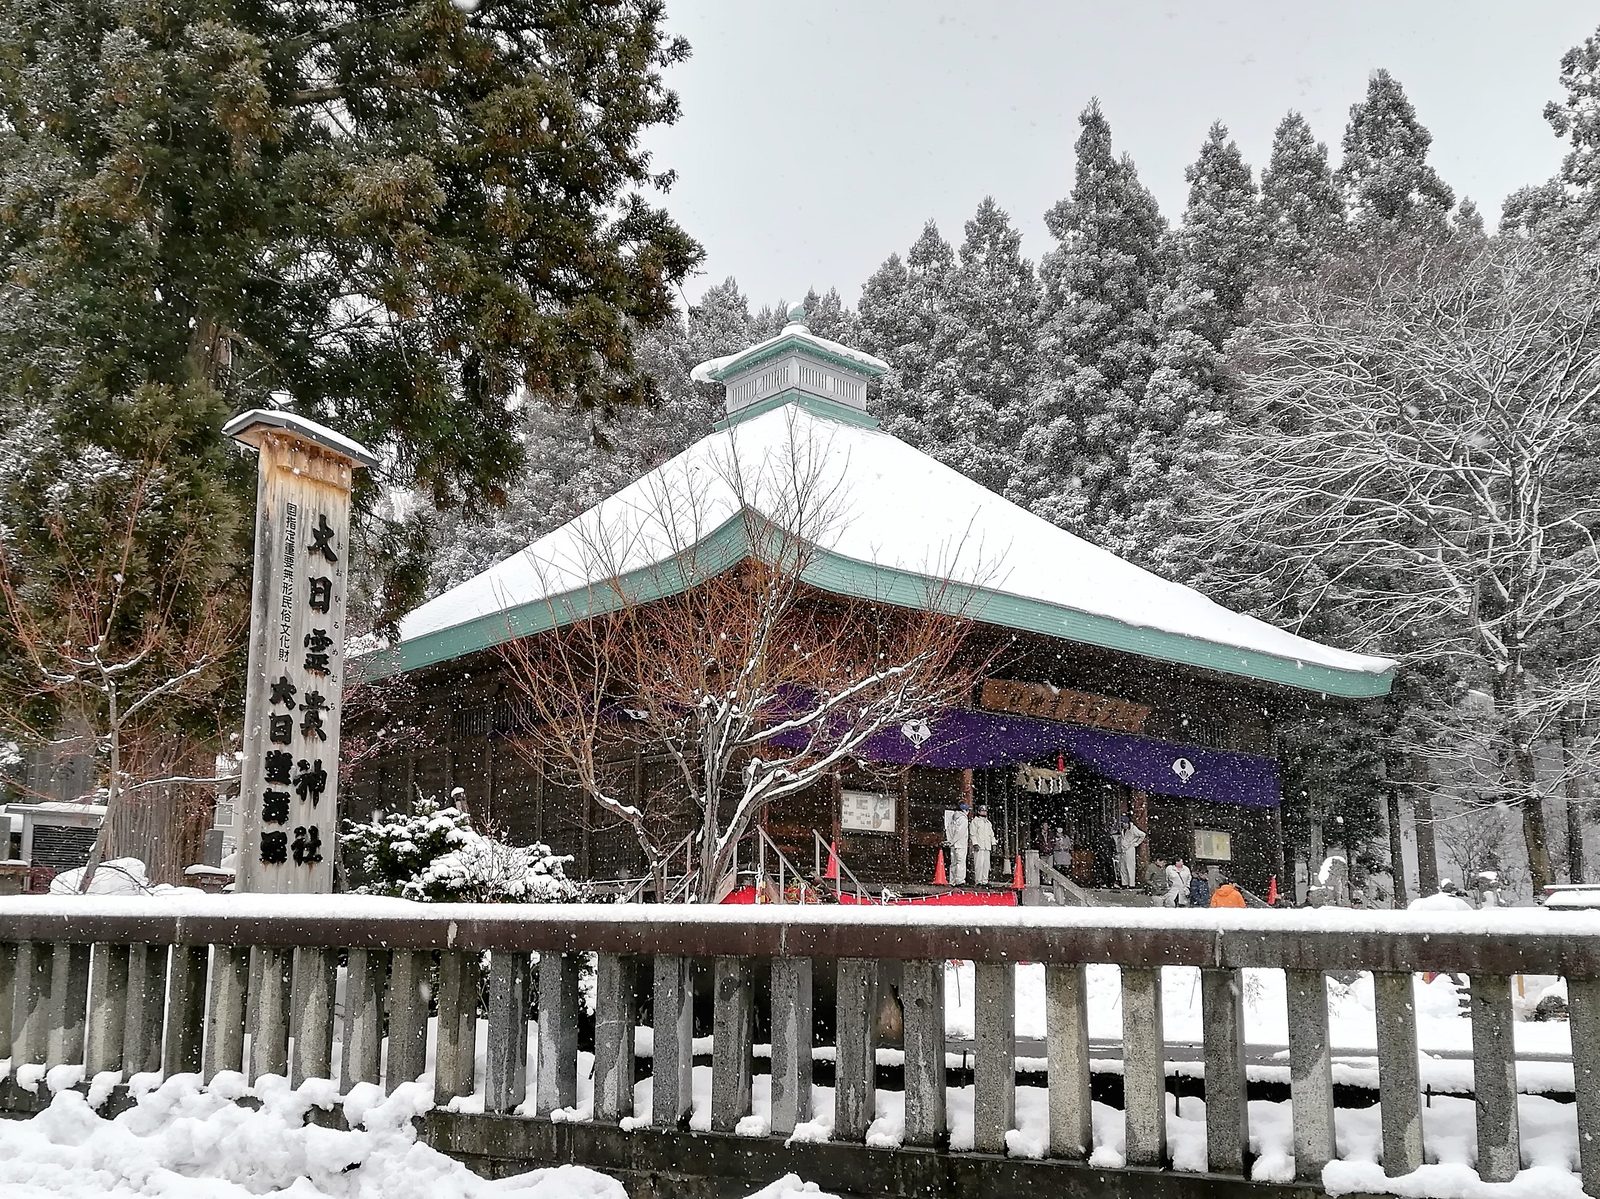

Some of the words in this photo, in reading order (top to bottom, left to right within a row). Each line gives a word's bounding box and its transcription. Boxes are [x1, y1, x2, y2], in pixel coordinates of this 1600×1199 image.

[278, 503, 297, 662] 国指定重要無形民俗文化財
[291, 514, 338, 866] 大日霊貴神社
